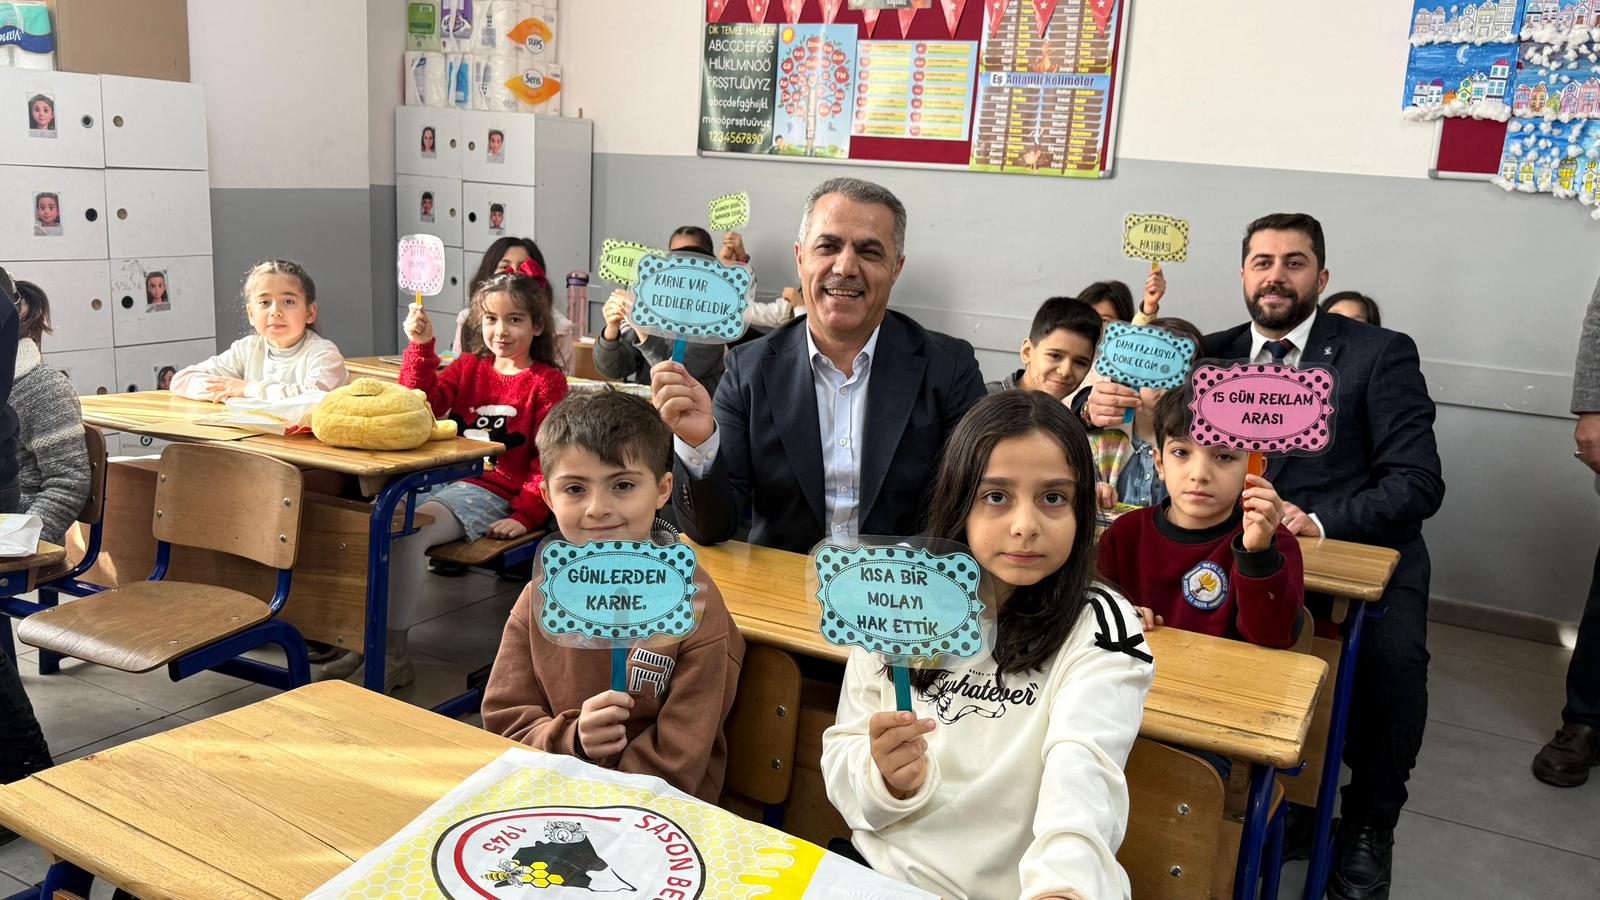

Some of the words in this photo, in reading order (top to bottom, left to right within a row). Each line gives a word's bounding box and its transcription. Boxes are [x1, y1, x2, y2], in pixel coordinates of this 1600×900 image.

[708, 38, 774, 53] ABCÇDEFGĞ
[525, 73, 541, 85] Sens
[1045, 75, 1094, 87] Kelimeler
[708, 130, 763, 144] 1234567890
[1143, 223, 1168, 235] KARNE
[1140, 239, 1171, 252] HATIRASI
[606, 253, 621, 265] KISA
[654, 273, 687, 289] KARNE
[688, 279, 708, 293] VAR
[652, 294, 693, 312] DEDİLER
[1115, 339, 1134, 351] DAHA
[1134, 343, 1176, 361] FAZLASIYLA
[1212, 391, 1225, 403] 15
[1229, 389, 1255, 404] GÜN
[1259, 392, 1313, 406] REKLAM
[1241, 412, 1283, 425] ARASI
[567, 565, 666, 585] GÜNLERDEN
[860, 566, 895, 583] KISA
[901, 565, 928, 586] BİR
[586, 595, 647, 611] KARNE.
[867, 591, 924, 610] MOLAYI
[857, 615, 887, 632] HAK
[893, 616, 938, 637] ETTİK
[482, 825, 528, 854] 1945
[633, 814, 694, 871] SASON
[652, 876, 692, 900] BE
